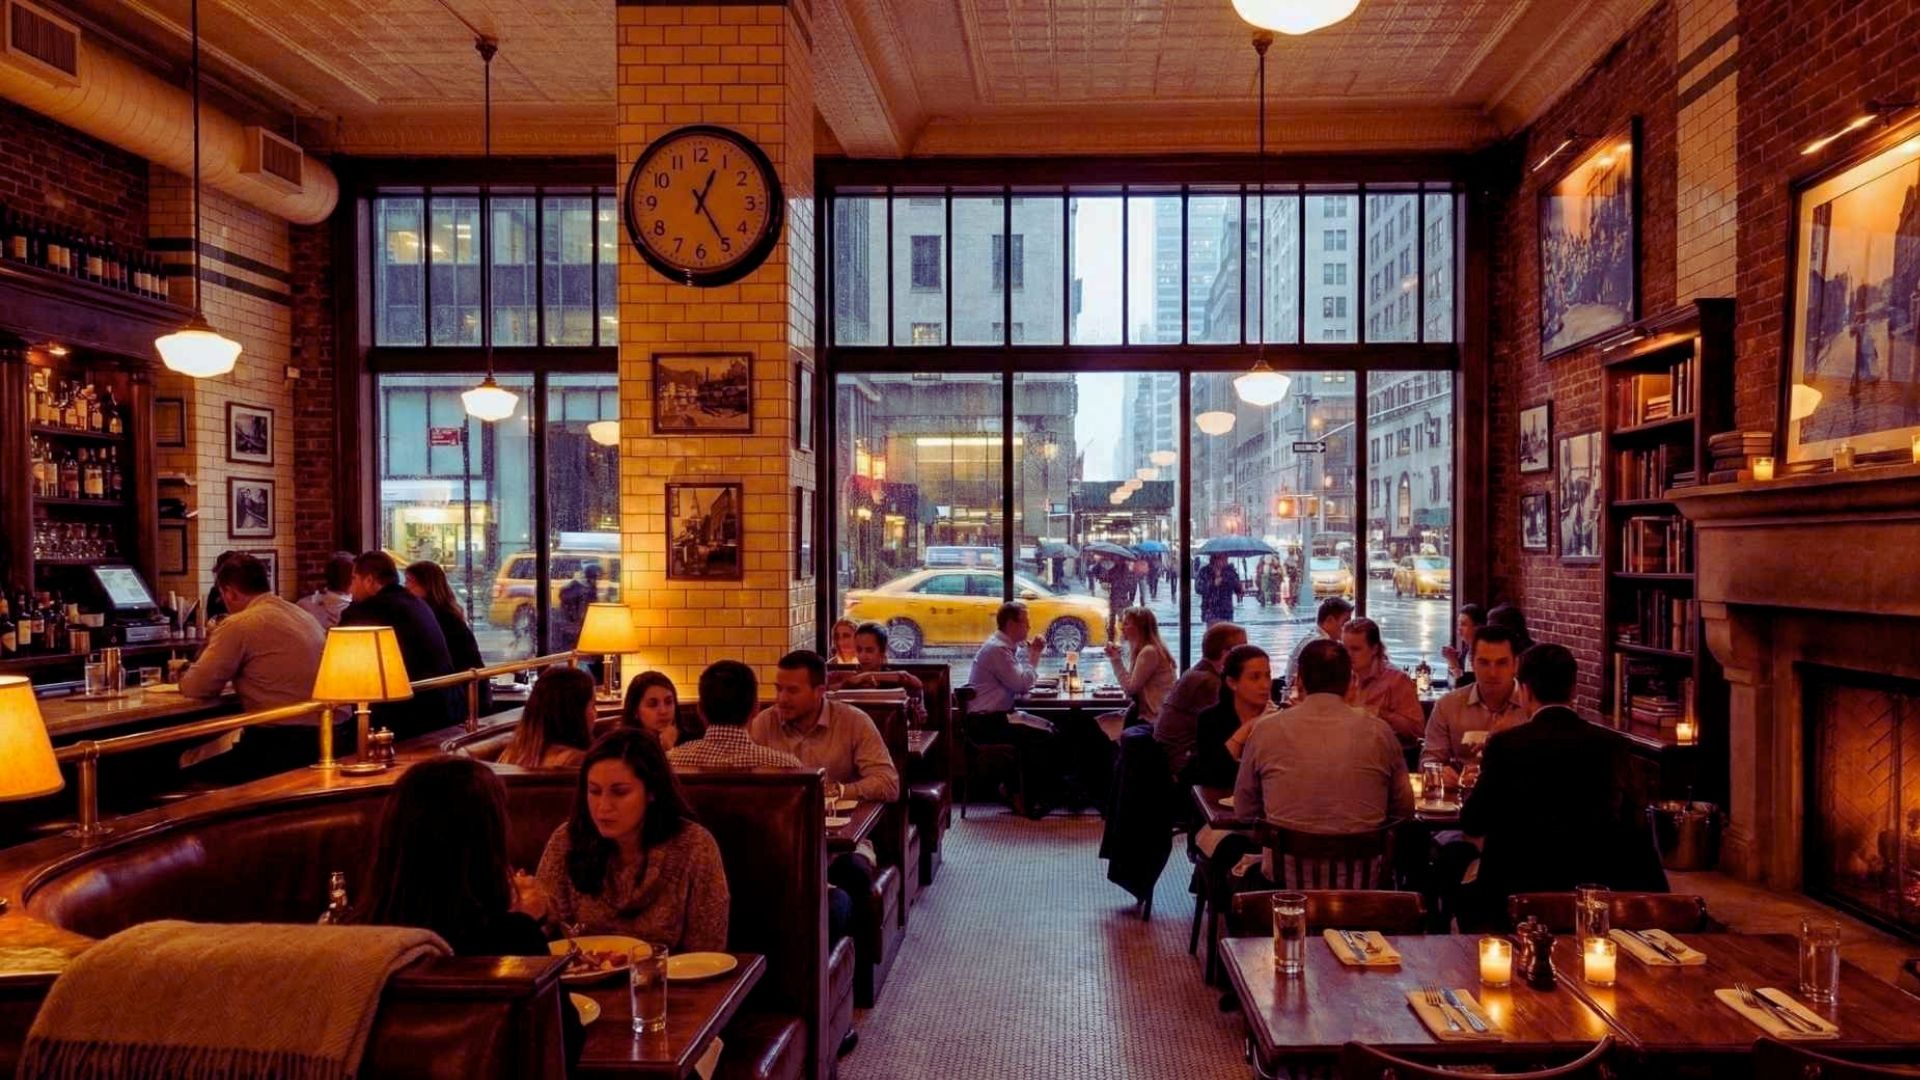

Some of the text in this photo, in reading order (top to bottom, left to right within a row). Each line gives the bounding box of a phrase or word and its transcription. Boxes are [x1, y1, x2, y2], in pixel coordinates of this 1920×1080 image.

[693, 148, 709, 162] 12
[723, 155, 727, 169] 1
[672, 156, 683, 170] 11
[654, 172, 669, 188] 10
[737, 171, 747, 186] 2
[647, 196, 657, 211] 9
[745, 196, 756, 211] 3
[654, 220, 665, 235] 8
[737, 221, 747, 234] 4
[673, 238, 683, 252] 7
[696, 244, 706, 259] 6
[721, 238, 731, 252] 5
